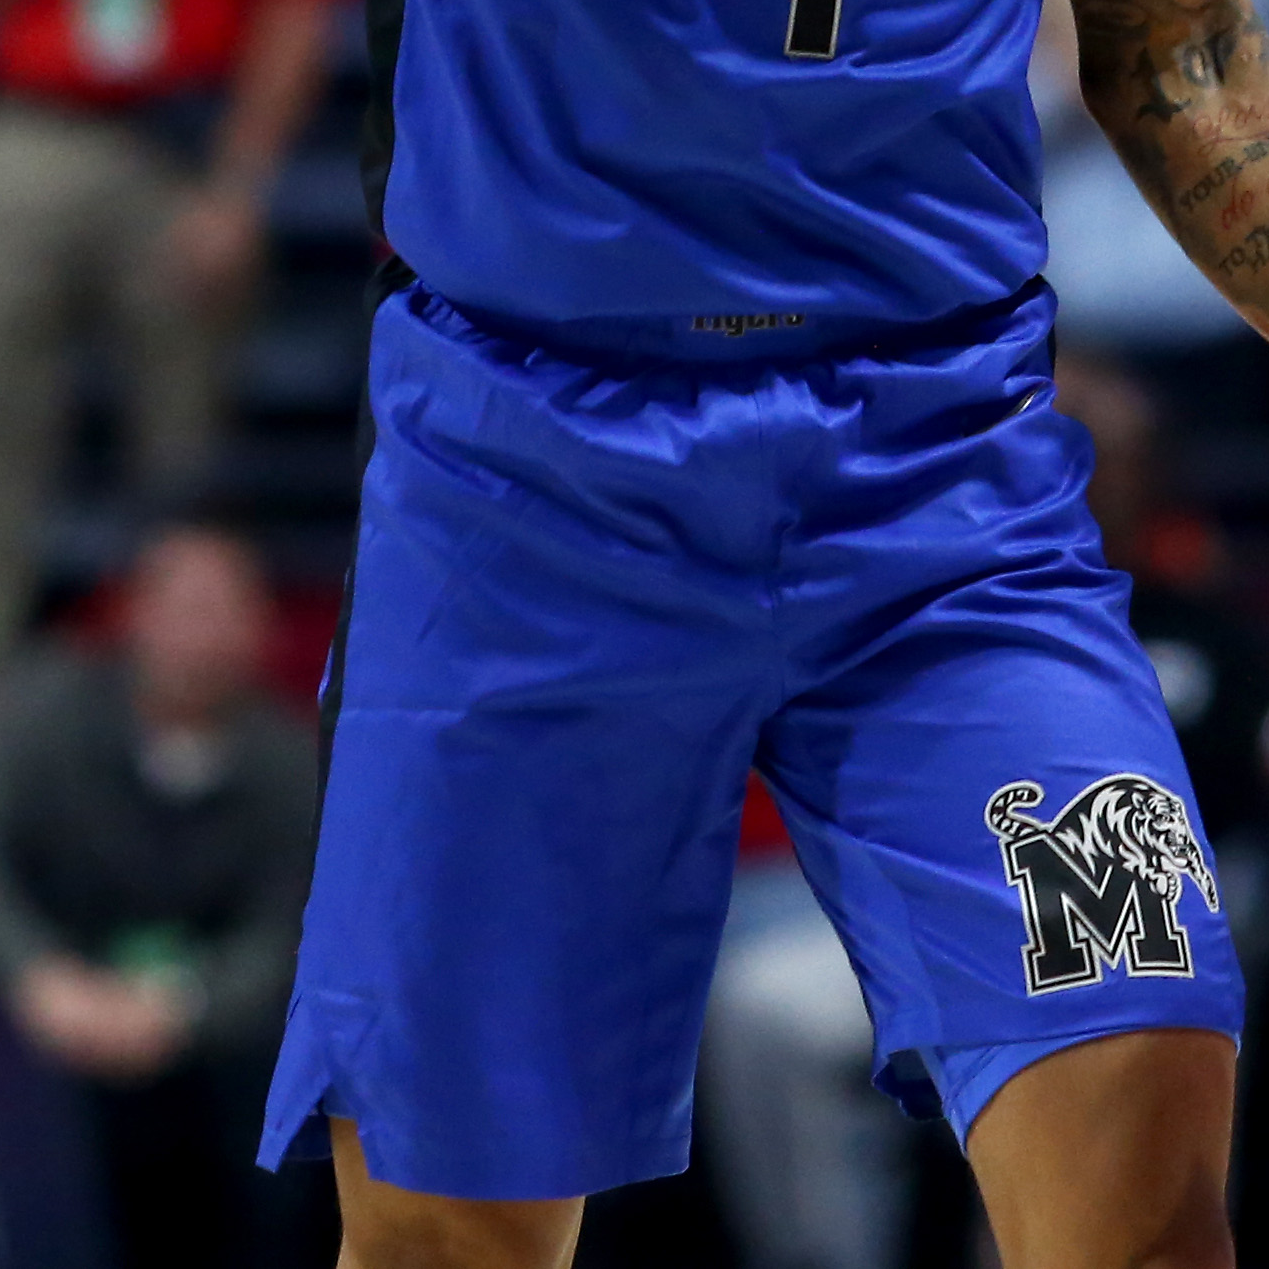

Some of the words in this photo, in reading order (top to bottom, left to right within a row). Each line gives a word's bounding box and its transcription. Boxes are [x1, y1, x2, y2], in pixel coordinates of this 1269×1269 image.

[1180, 155, 1243, 212] YOUR
[1221, 177, 1255, 231] do
[998, 828, 1196, 998] M
